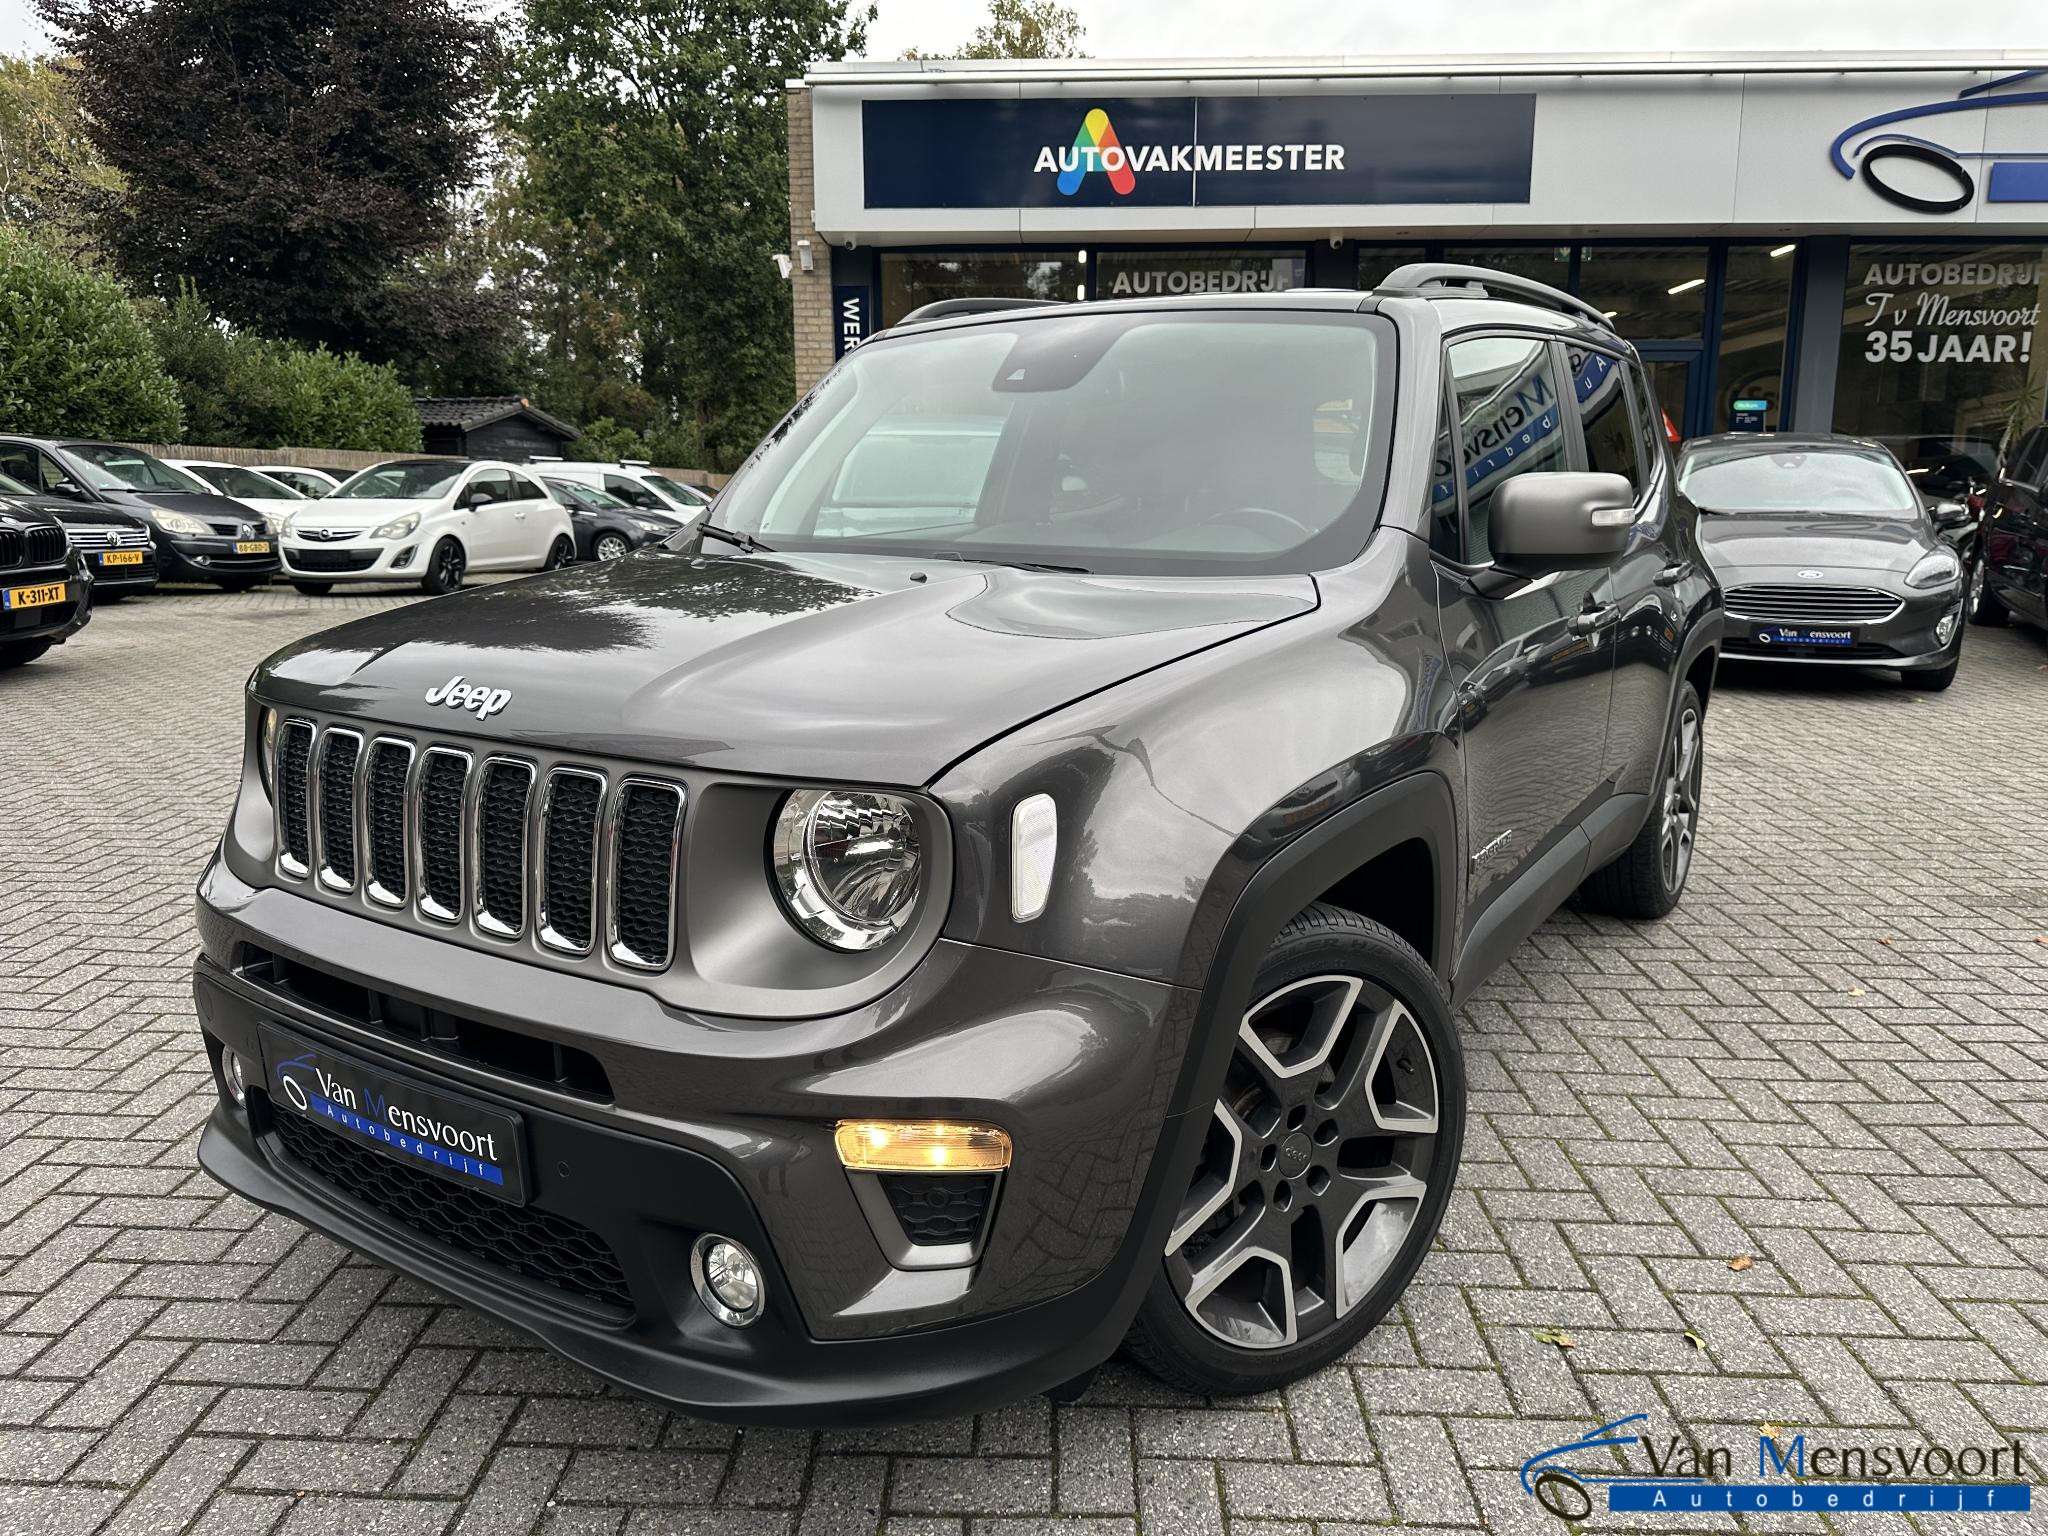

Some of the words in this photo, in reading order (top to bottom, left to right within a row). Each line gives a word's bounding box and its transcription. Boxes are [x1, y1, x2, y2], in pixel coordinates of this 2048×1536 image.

[1034, 144, 1346, 173] AUTOVAKMEESTER
[1864, 293, 1895, 327] T
[1894, 308, 1908, 326] v
[1916, 292, 2041, 326] Mensvoort
[1864, 330, 1913, 363] 35
[1917, 331, 2032, 363] JAAR!
[106, 552, 140, 564] KP-166-V
[18, 586, 60, 606] K-311-XT
[1802, 629, 1852, 639] ensvoort
[425, 676, 512, 721] Jeep
[315, 1067, 357, 1110] Van
[363, 1088, 498, 1161] Mensvoort
[327, 1104, 486, 1176] Autobedrijf
